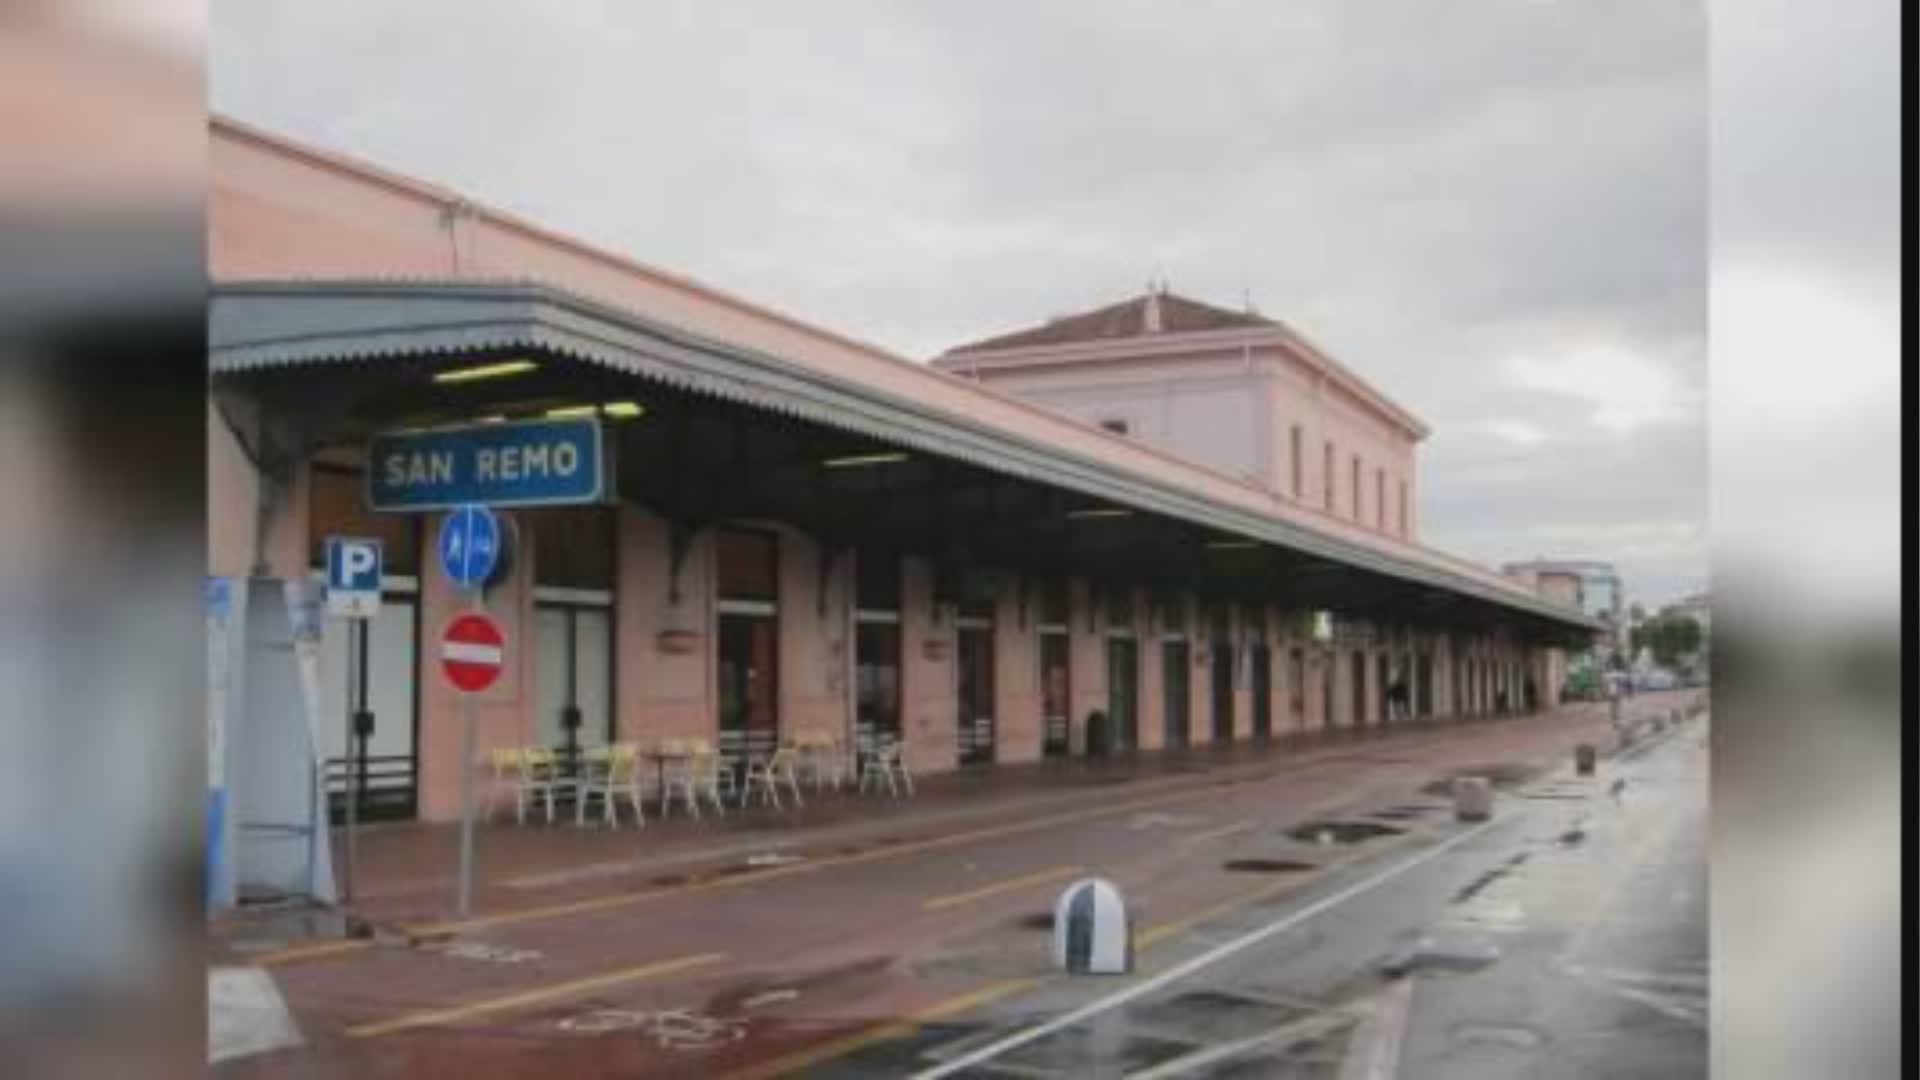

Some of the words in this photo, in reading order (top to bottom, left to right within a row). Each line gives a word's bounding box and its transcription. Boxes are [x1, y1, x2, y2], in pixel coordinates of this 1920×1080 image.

[384, 451, 454, 486] SAN
[477, 442, 577, 482] REMO
[341, 545, 375, 585] P
